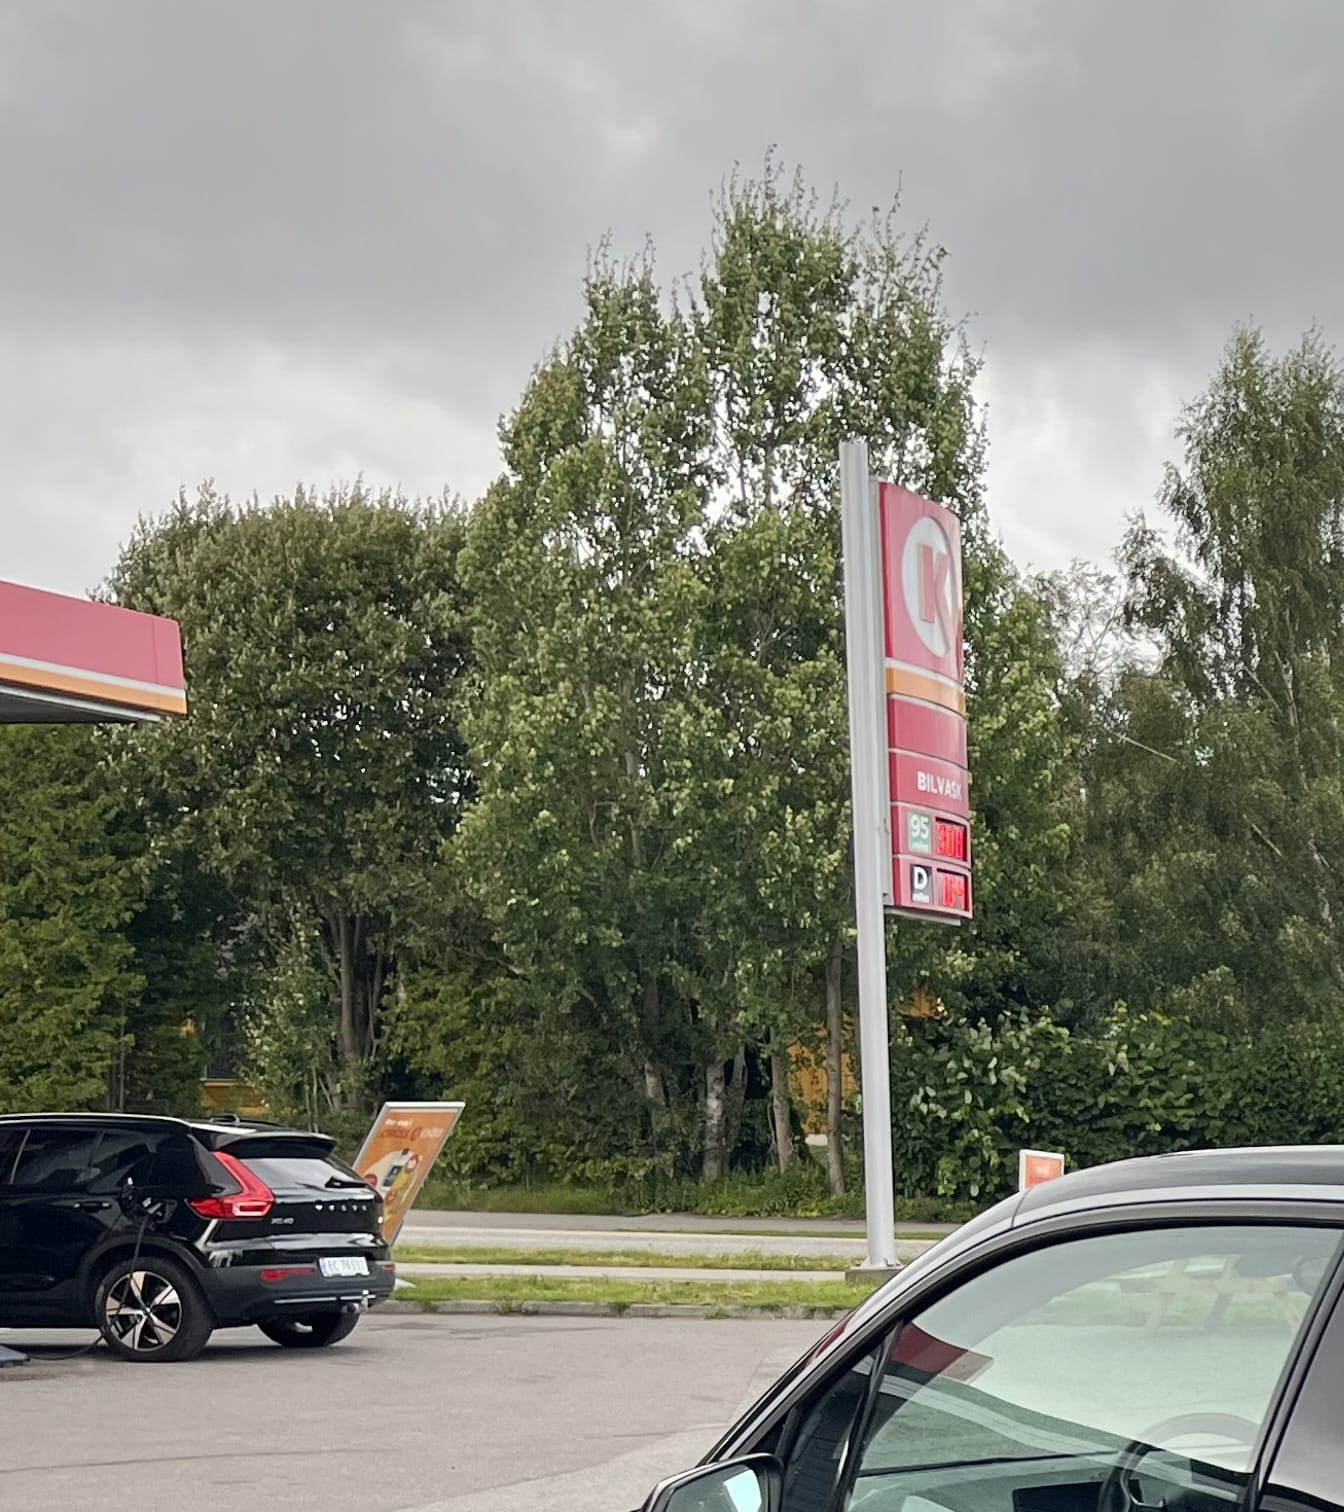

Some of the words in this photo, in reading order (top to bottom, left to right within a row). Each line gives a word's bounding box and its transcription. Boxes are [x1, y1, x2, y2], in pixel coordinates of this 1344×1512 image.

[917, 771, 962, 800] BILVASK
[910, 814, 929, 838] 95
[913, 866, 928, 890] D
